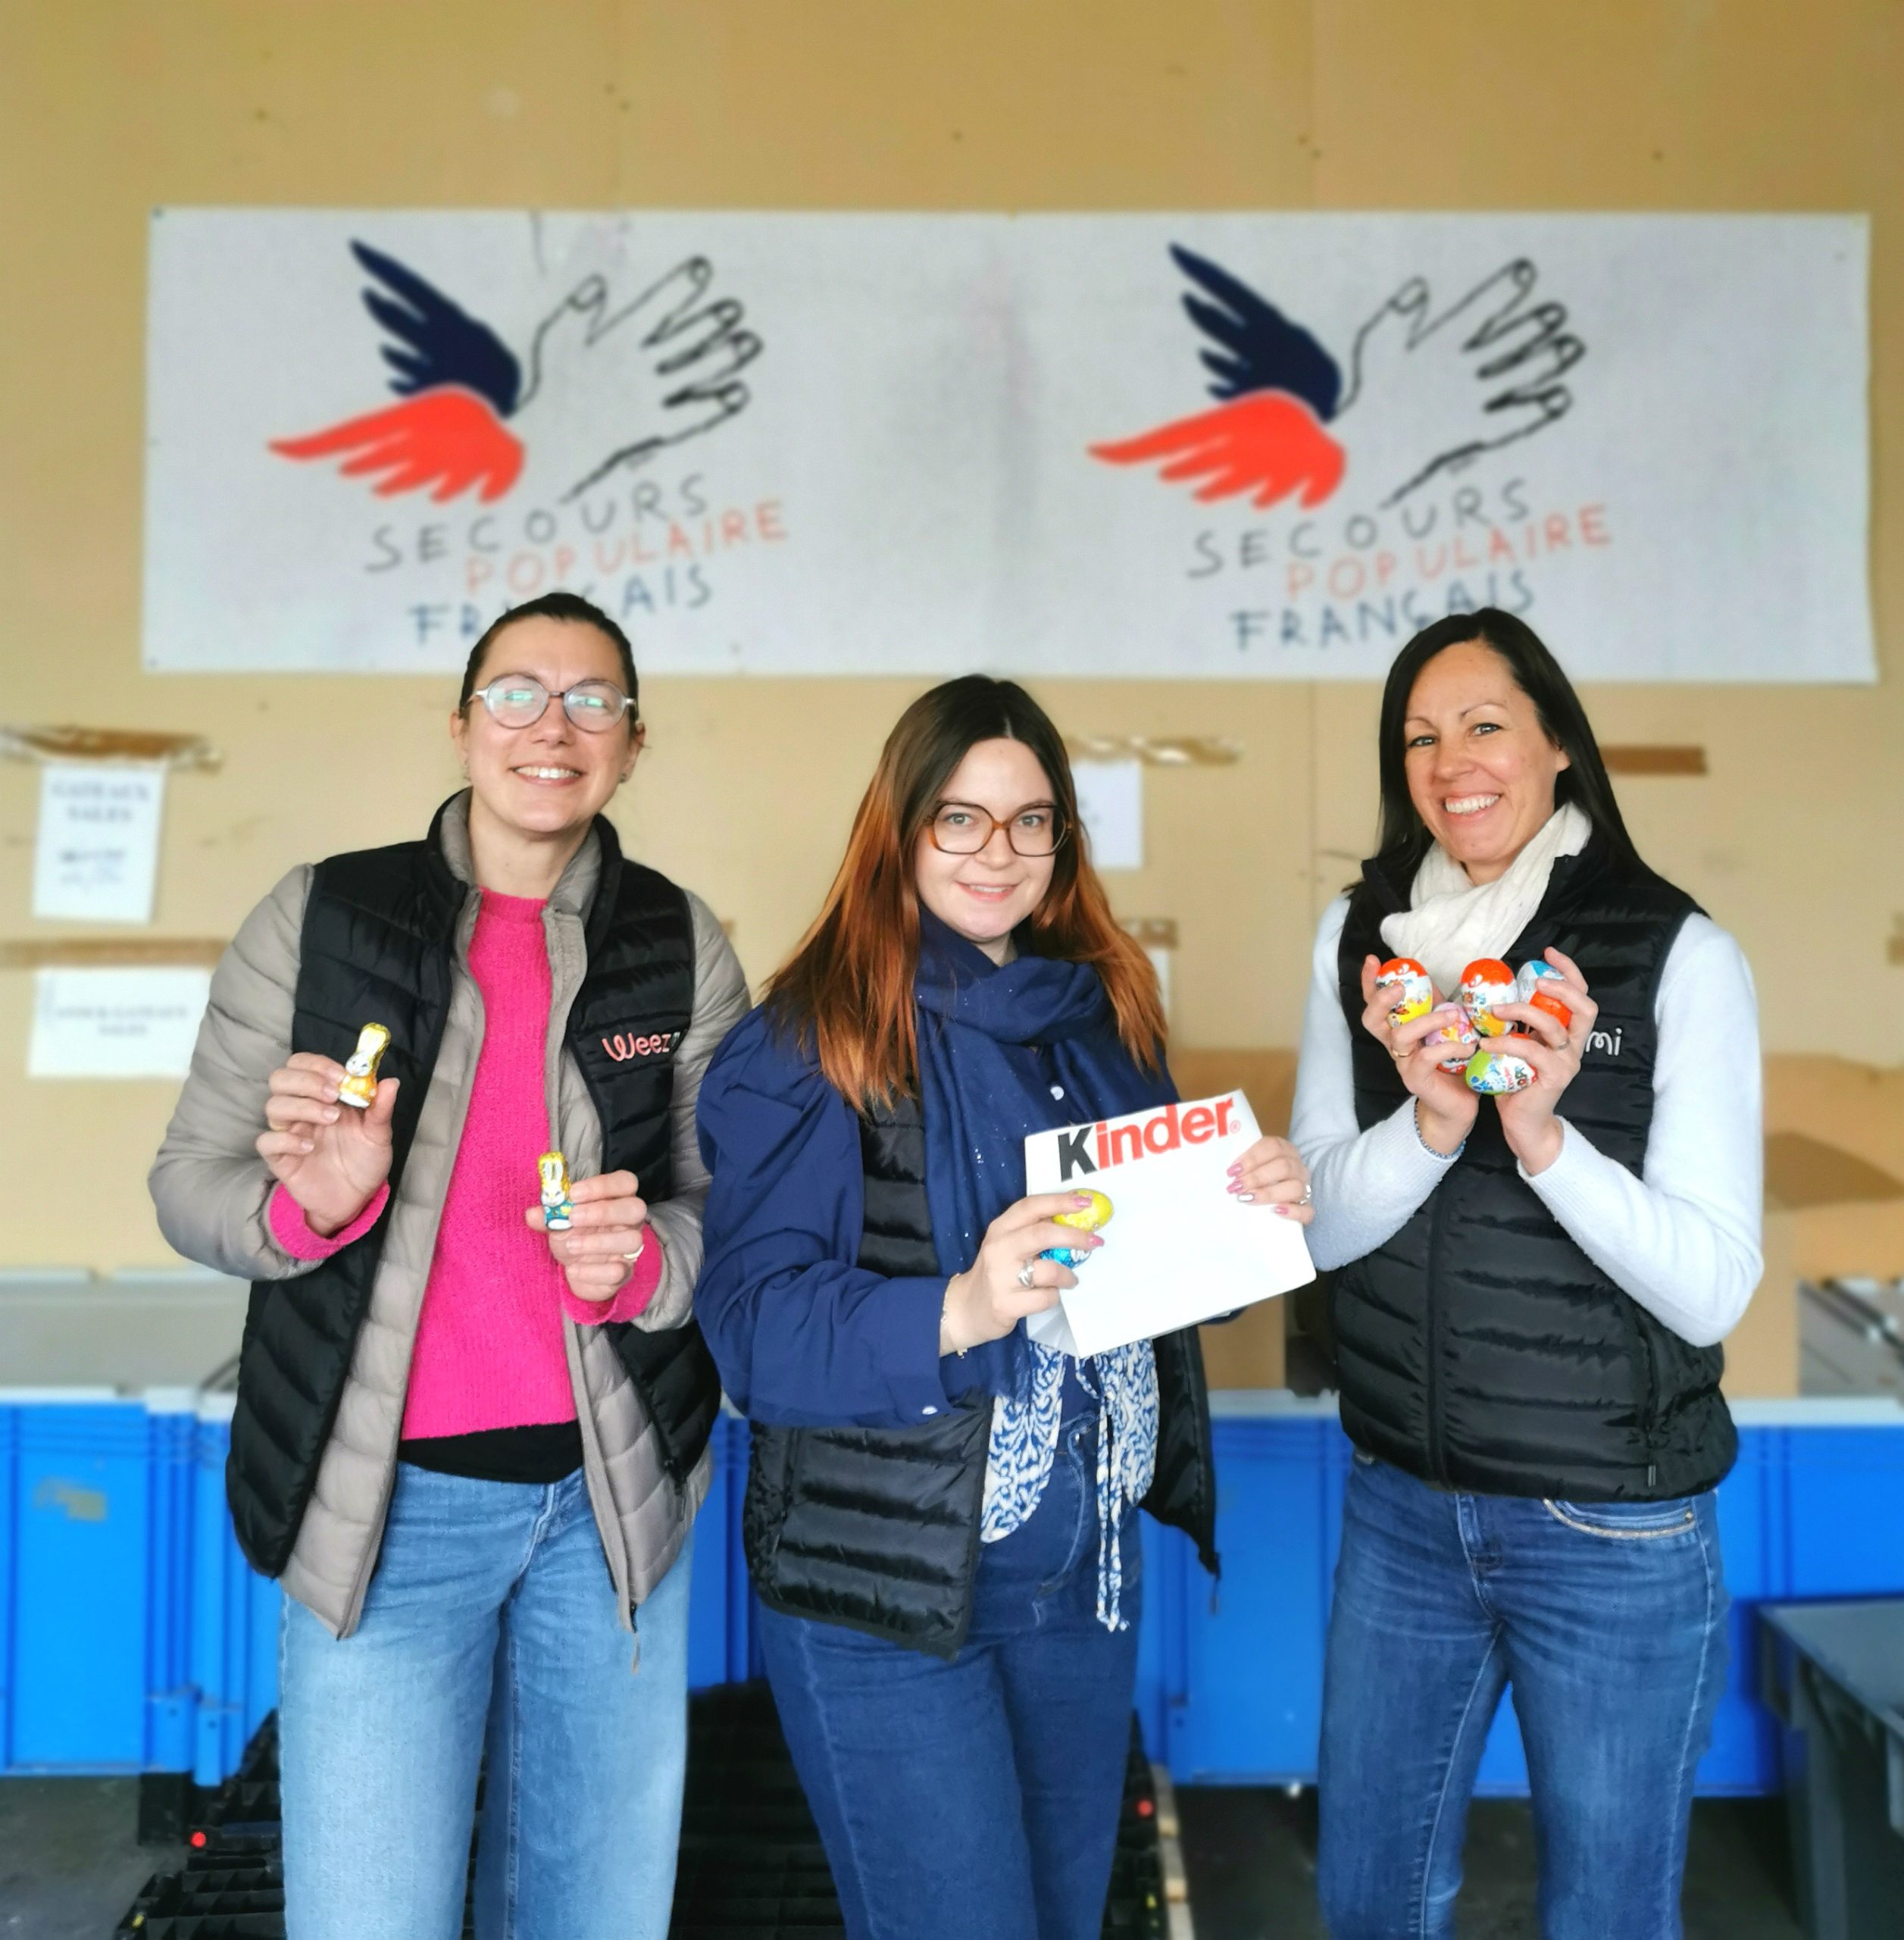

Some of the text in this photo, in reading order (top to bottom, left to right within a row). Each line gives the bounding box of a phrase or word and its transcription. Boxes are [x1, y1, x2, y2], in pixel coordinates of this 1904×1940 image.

[364, 473, 708, 573] SECOURS
[465, 500, 788, 596] POPULAIRE
[1186, 478, 1530, 579] SECOURS
[1287, 504, 1612, 603] POPULAIRE
[408, 563, 714, 648] FRAIS
